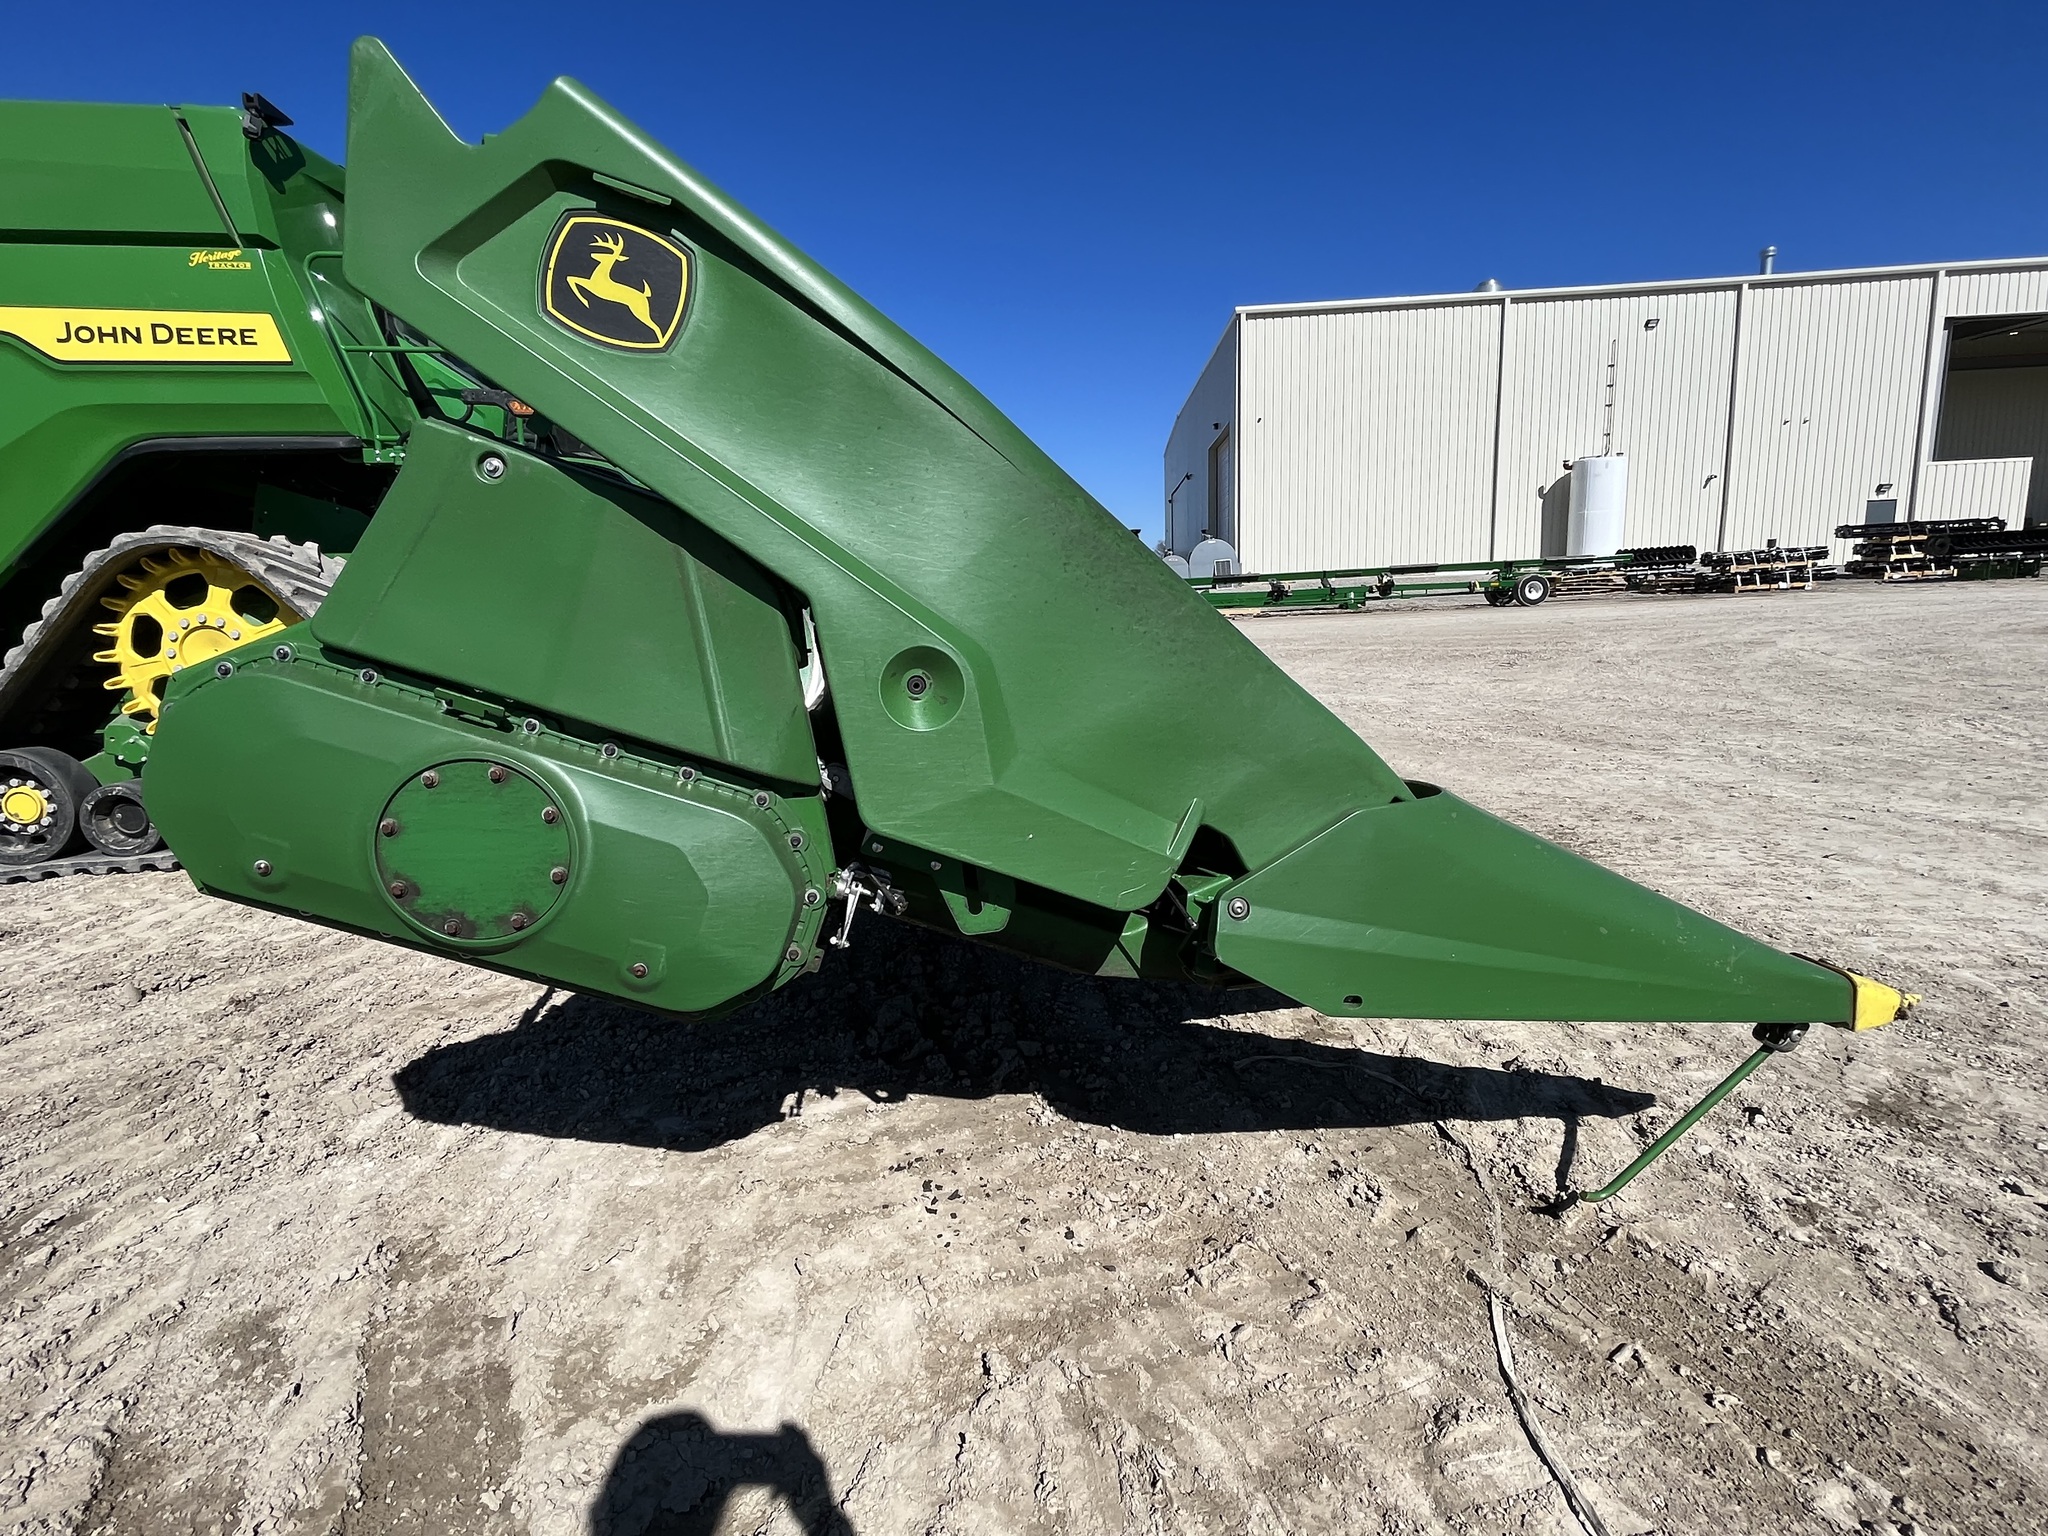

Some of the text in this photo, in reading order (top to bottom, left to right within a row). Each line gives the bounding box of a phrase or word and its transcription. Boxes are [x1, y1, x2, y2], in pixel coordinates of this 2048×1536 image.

[189, 250, 242, 266] Heritage
[56, 322, 258, 345] JOHN DEERE
